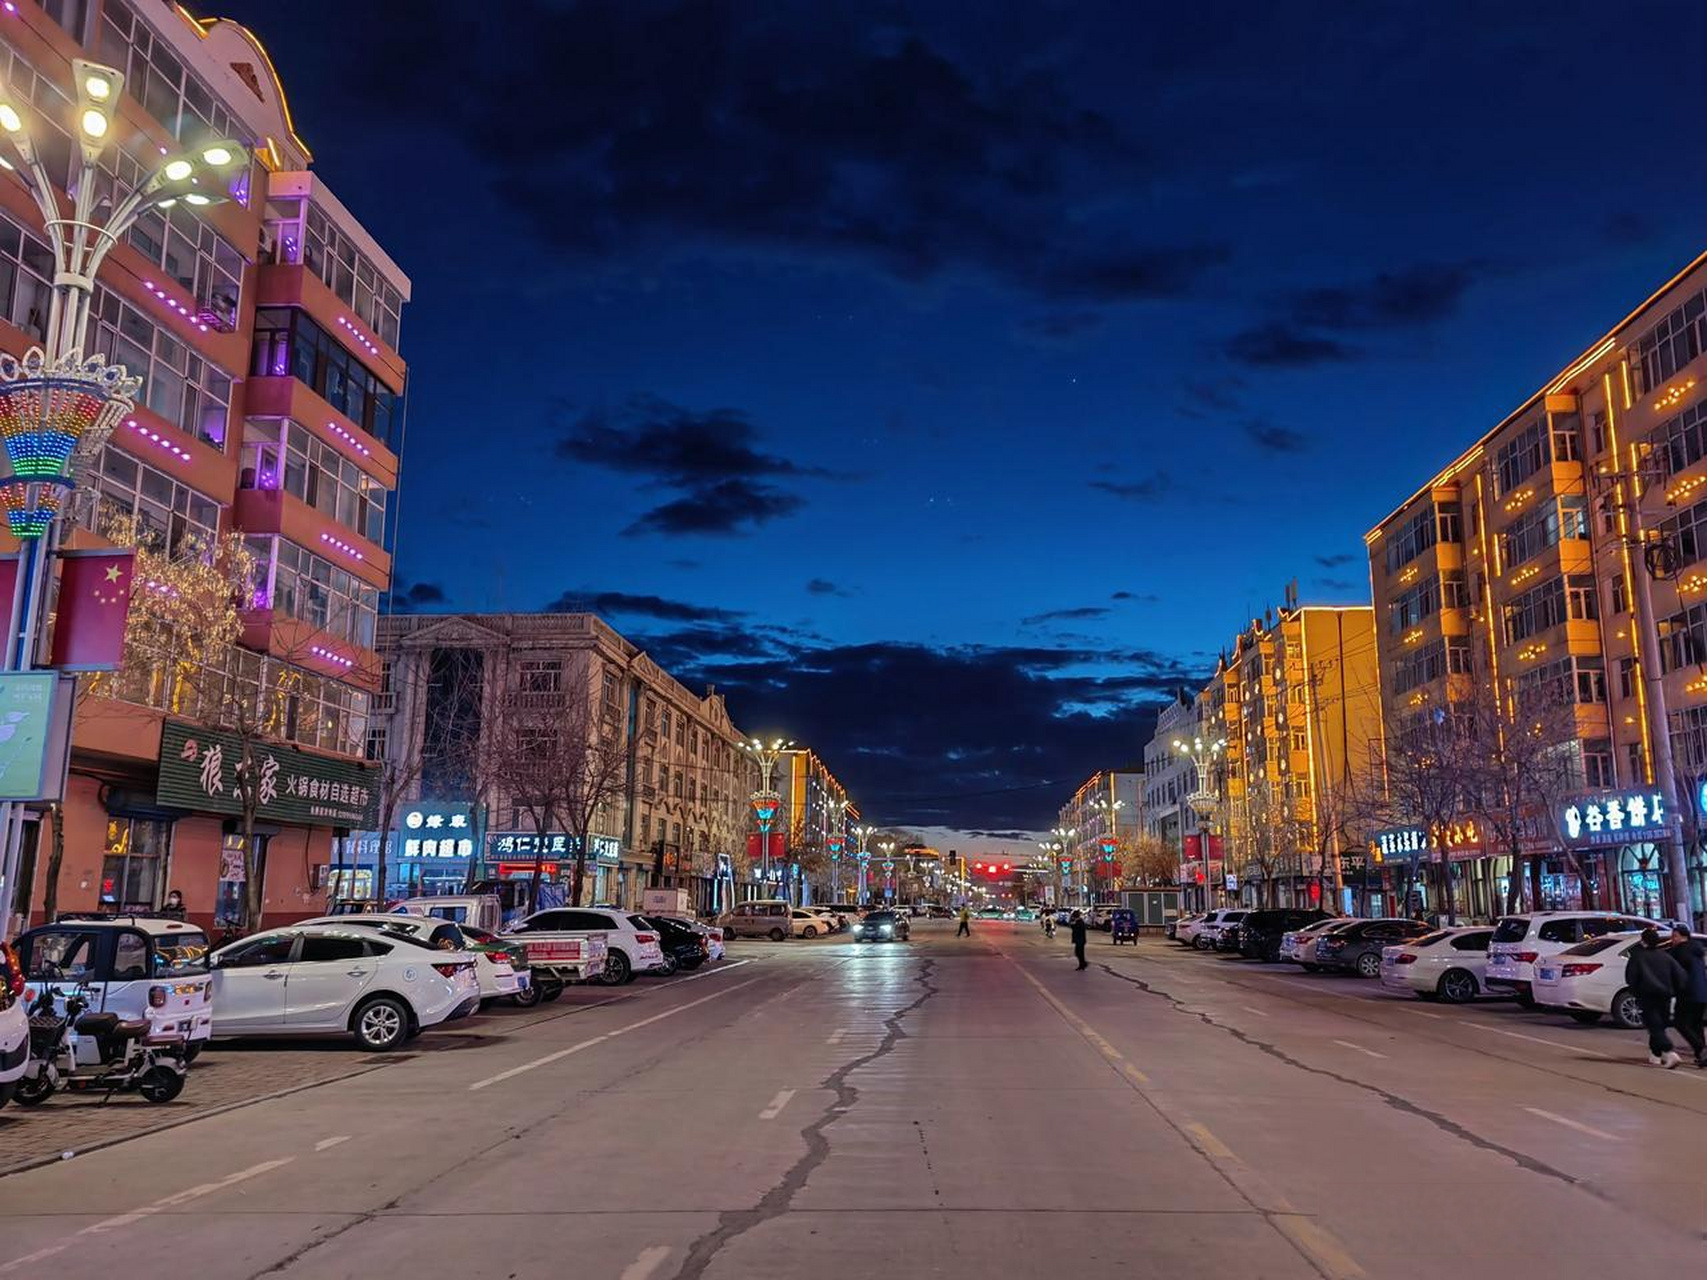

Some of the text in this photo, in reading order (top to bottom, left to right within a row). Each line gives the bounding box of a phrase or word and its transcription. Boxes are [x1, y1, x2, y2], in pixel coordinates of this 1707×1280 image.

[286, 774, 369, 807] 火锅食材自选超市
